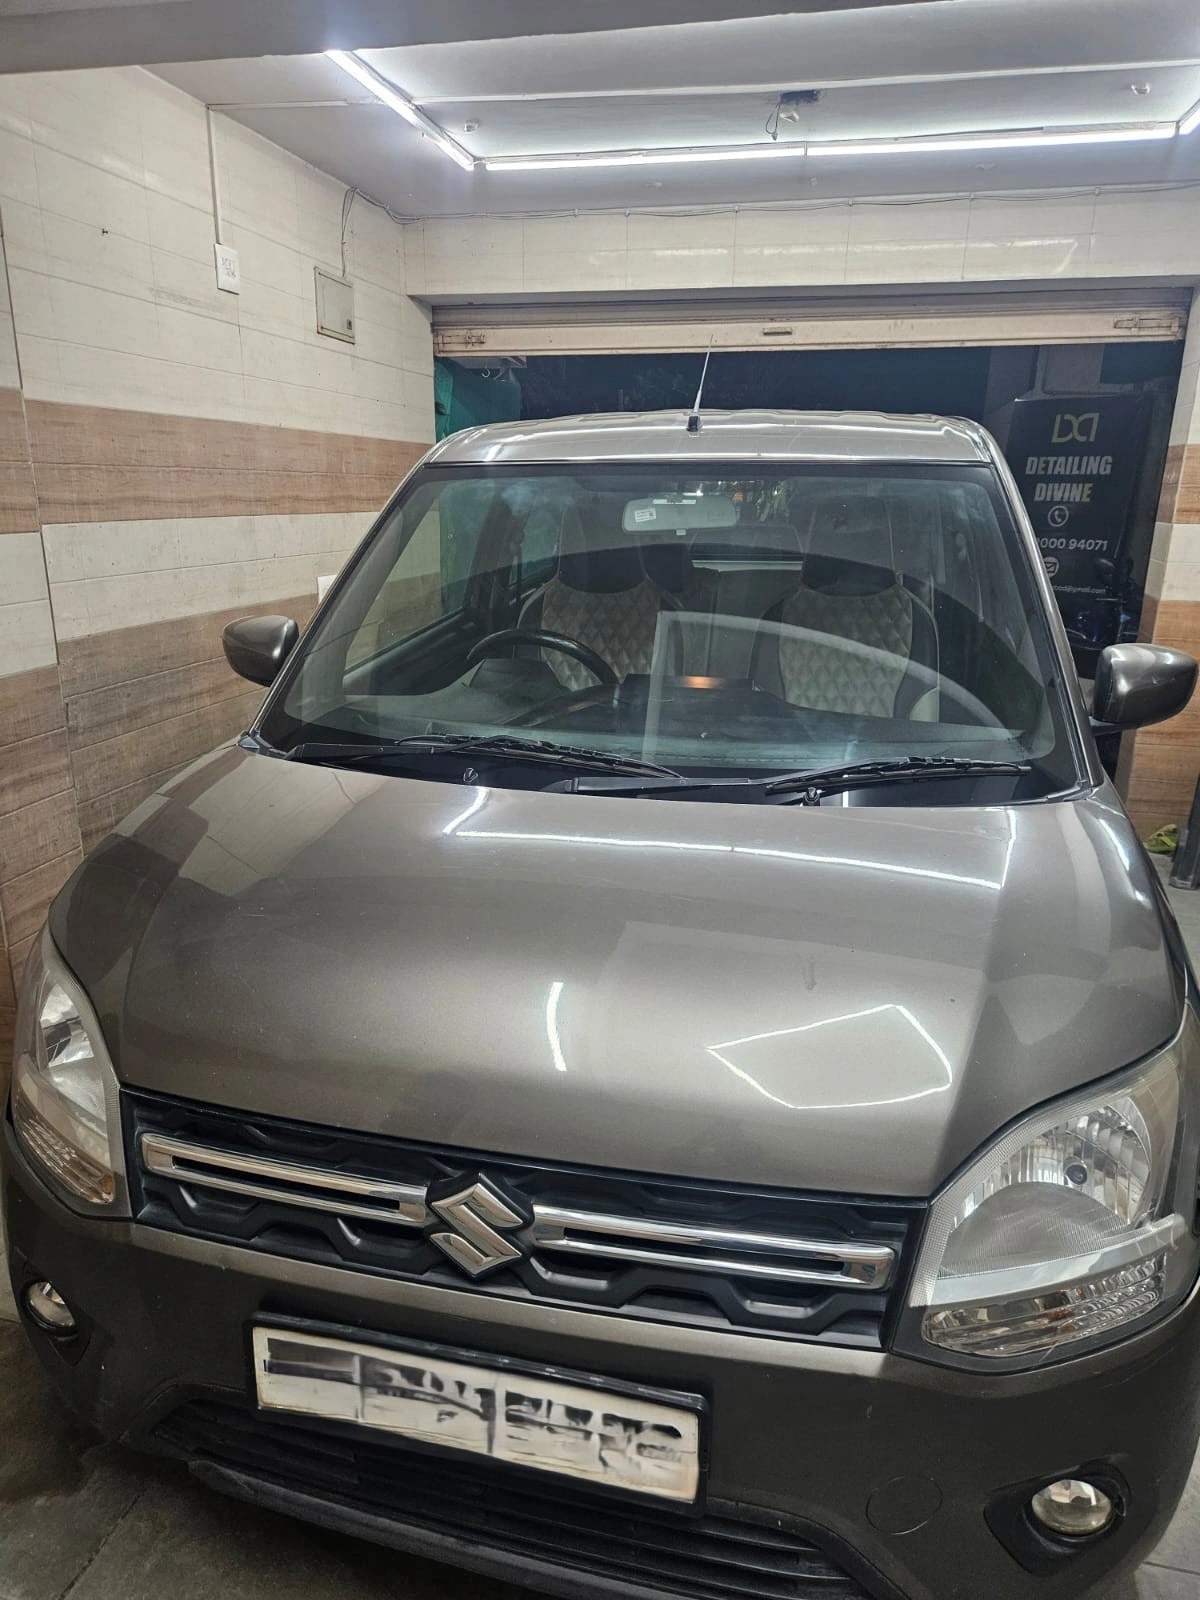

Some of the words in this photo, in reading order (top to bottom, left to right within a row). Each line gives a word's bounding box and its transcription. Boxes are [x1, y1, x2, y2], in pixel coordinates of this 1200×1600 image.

[1026, 456, 1112, 475] DETAILING
[1034, 483, 1093, 502] DIVINE
[1037, 537, 1065, 549] 000
[1068, 539, 1108, 551] 94071
